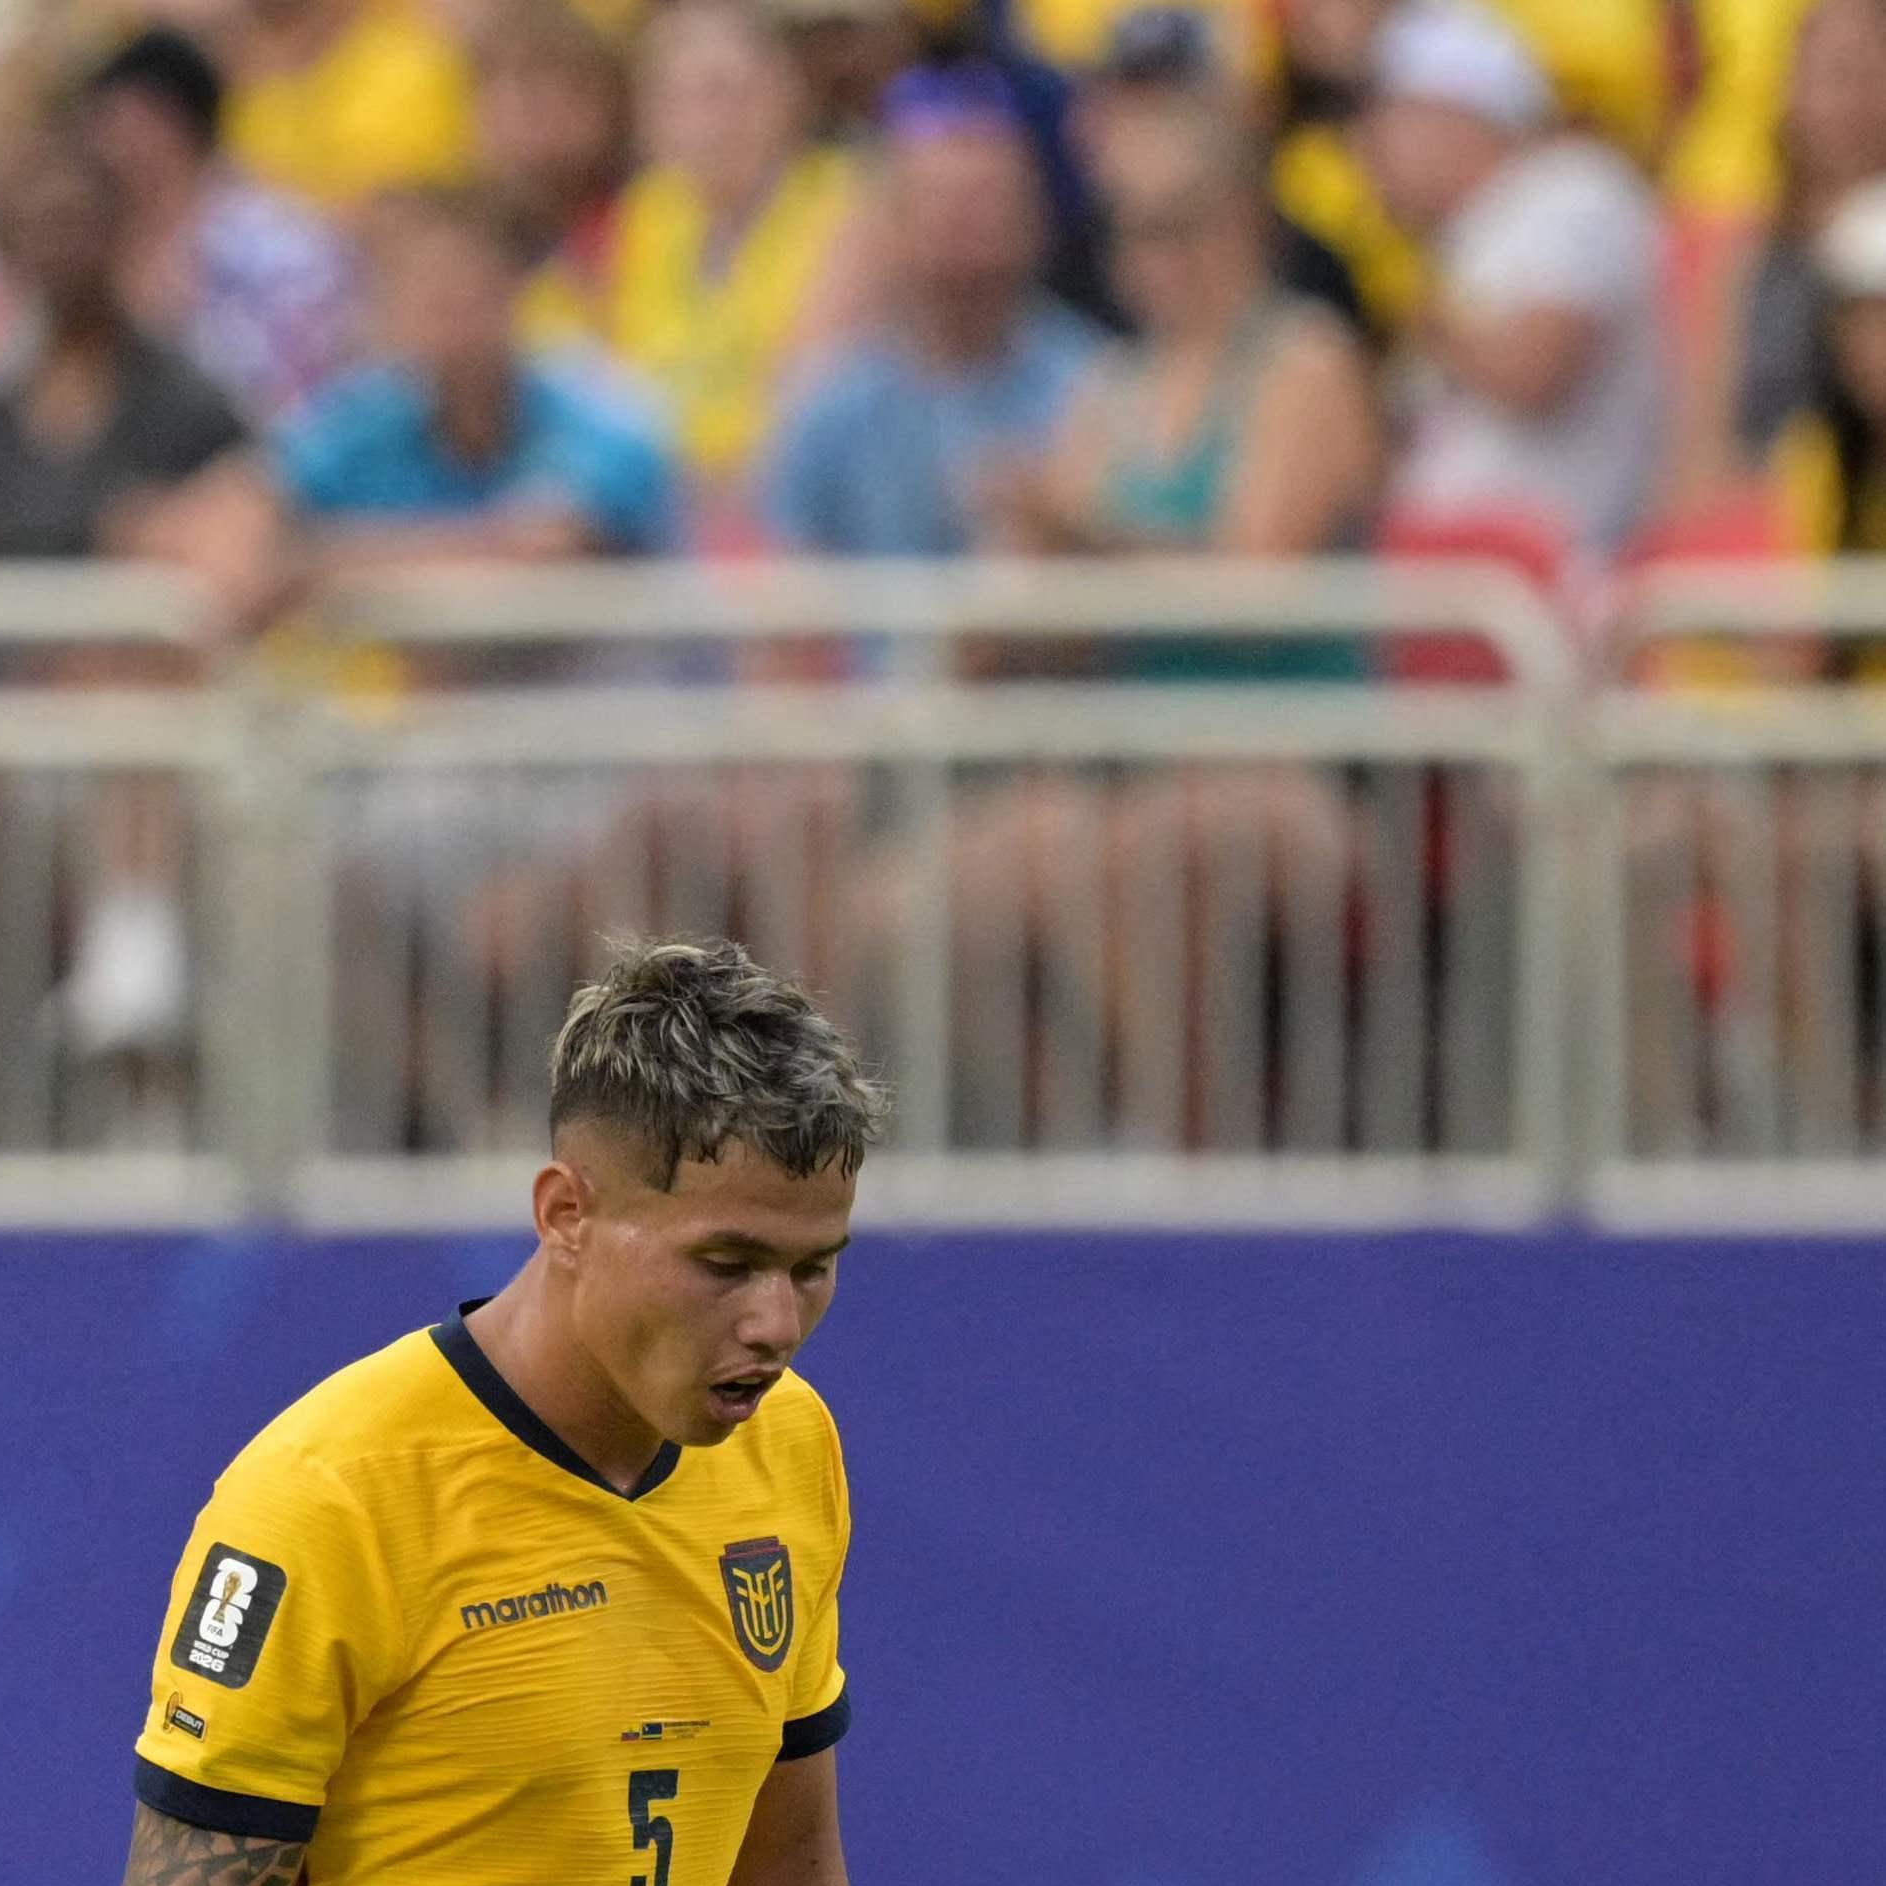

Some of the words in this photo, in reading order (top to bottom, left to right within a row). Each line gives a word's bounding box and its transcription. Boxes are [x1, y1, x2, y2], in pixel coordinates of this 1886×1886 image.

[459, 1580, 609, 1630] marathon
[207, 1624, 224, 1638] FIFA
[188, 1648, 226, 1673] 2026
[212, 1647, 229, 1660] CUP
